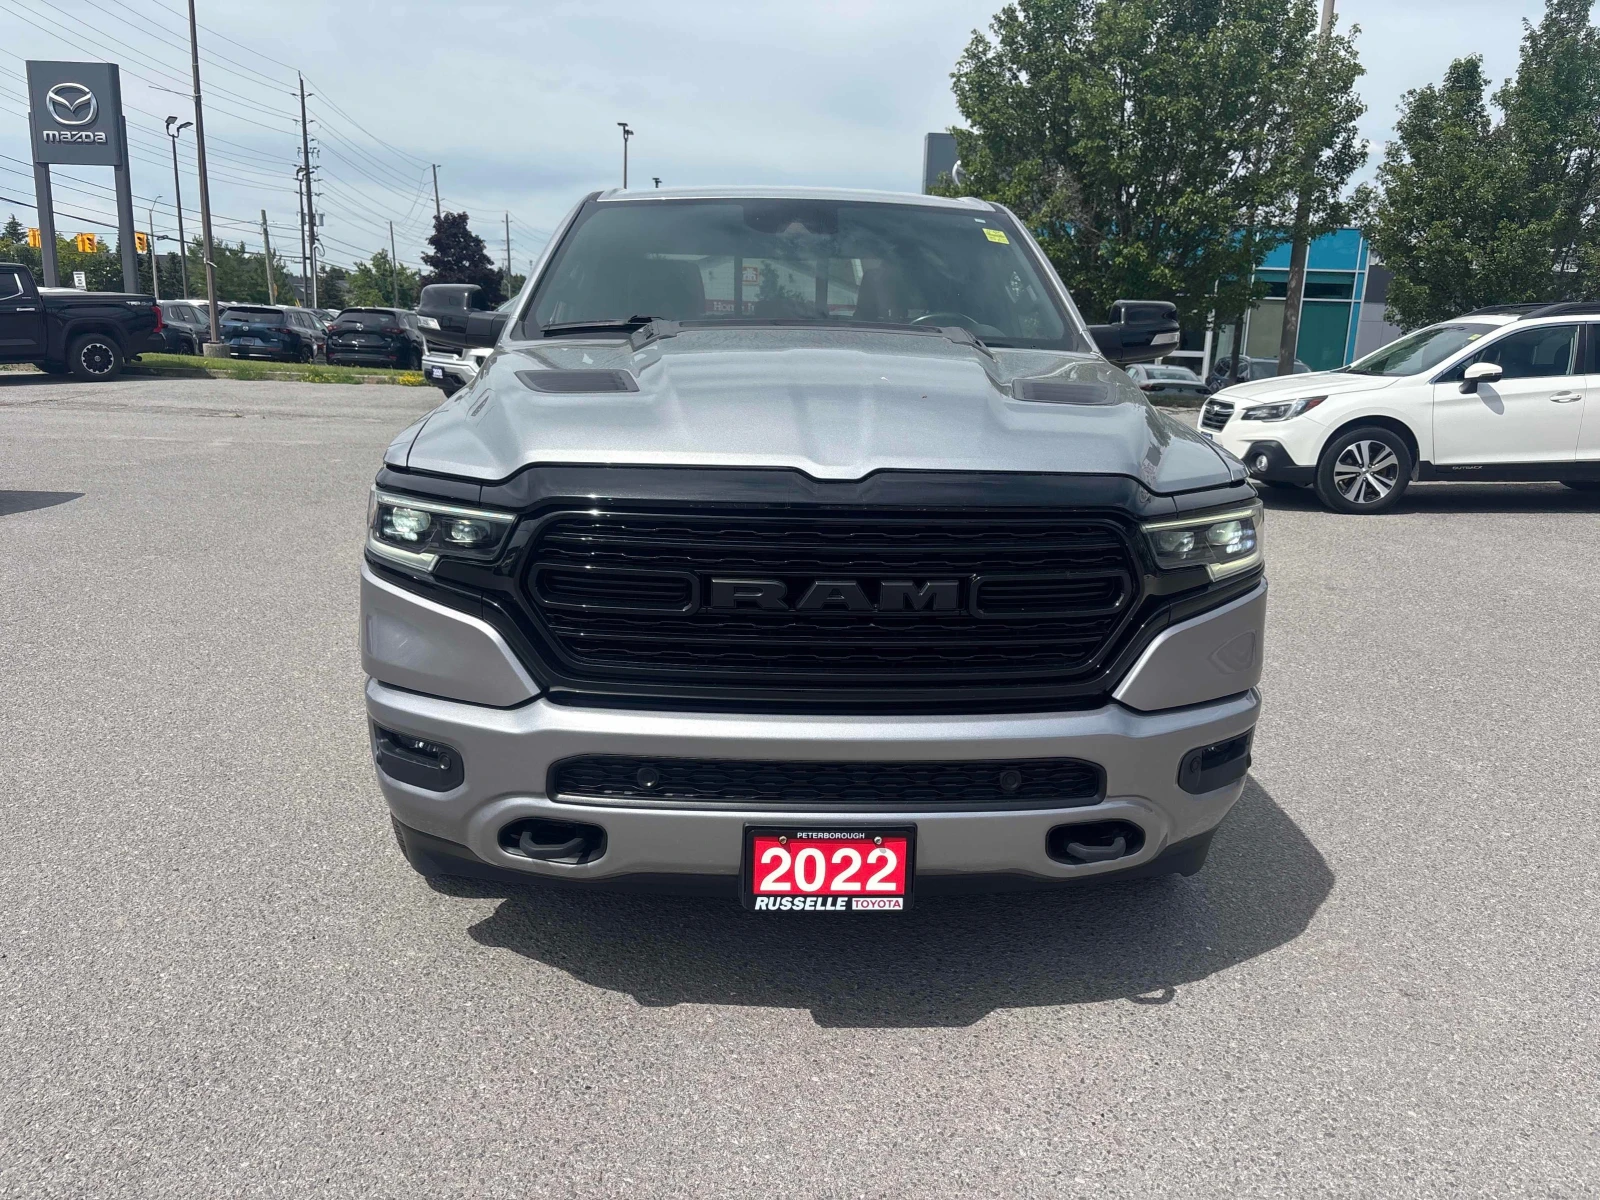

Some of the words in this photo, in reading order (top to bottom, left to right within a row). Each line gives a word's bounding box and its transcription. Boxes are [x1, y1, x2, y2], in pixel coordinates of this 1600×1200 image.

[711, 578, 959, 611] RAM
[760, 847, 897, 892] 2022
[755, 897, 848, 911] RUSSELLE
[853, 899, 901, 909] TOYOTA
